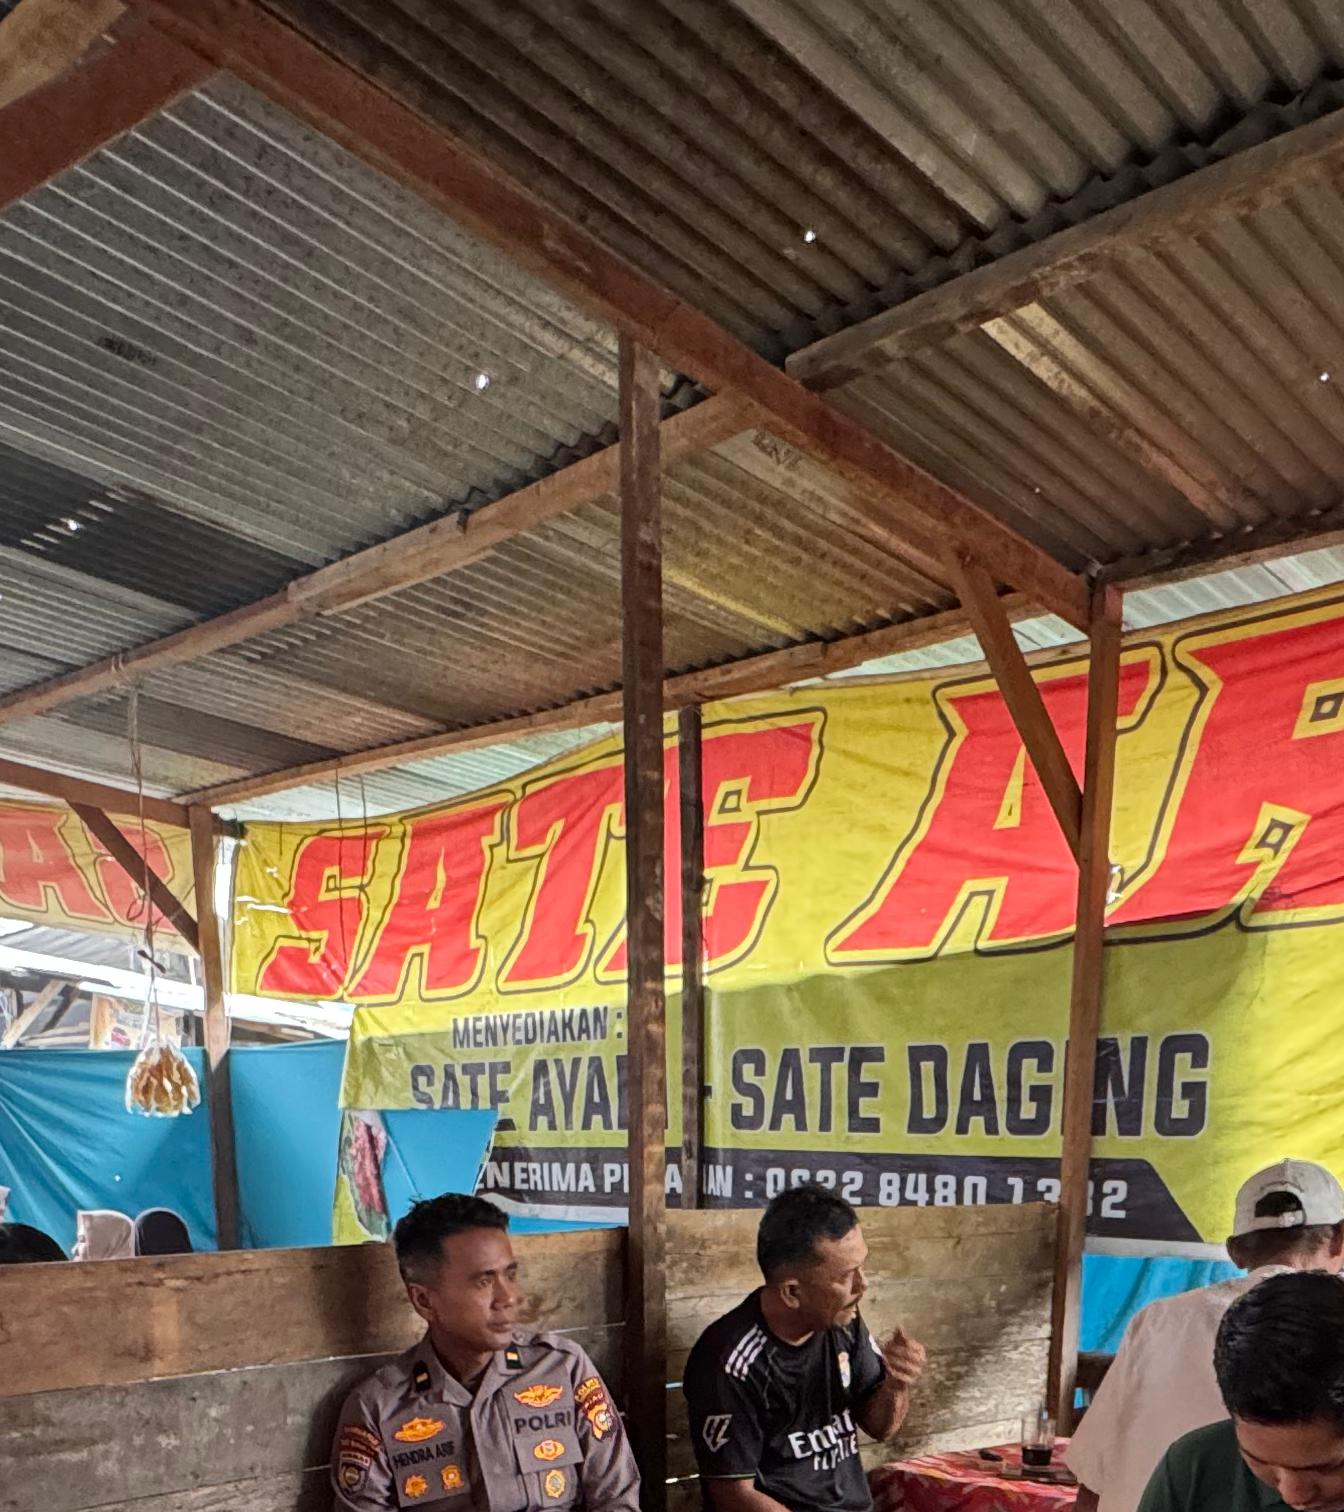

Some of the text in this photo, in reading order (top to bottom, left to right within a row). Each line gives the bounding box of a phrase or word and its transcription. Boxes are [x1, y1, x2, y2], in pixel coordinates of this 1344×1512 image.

[256, 706, 827, 1006] SATE
[452, 1006, 608, 1048] MENYEDIAKAN
[411, 1033, 1210, 1137] SATE AYA SATE DAGNG
[1007, 1176, 1129, 1219] 132
[514, 1410, 572, 1434] POLRI
